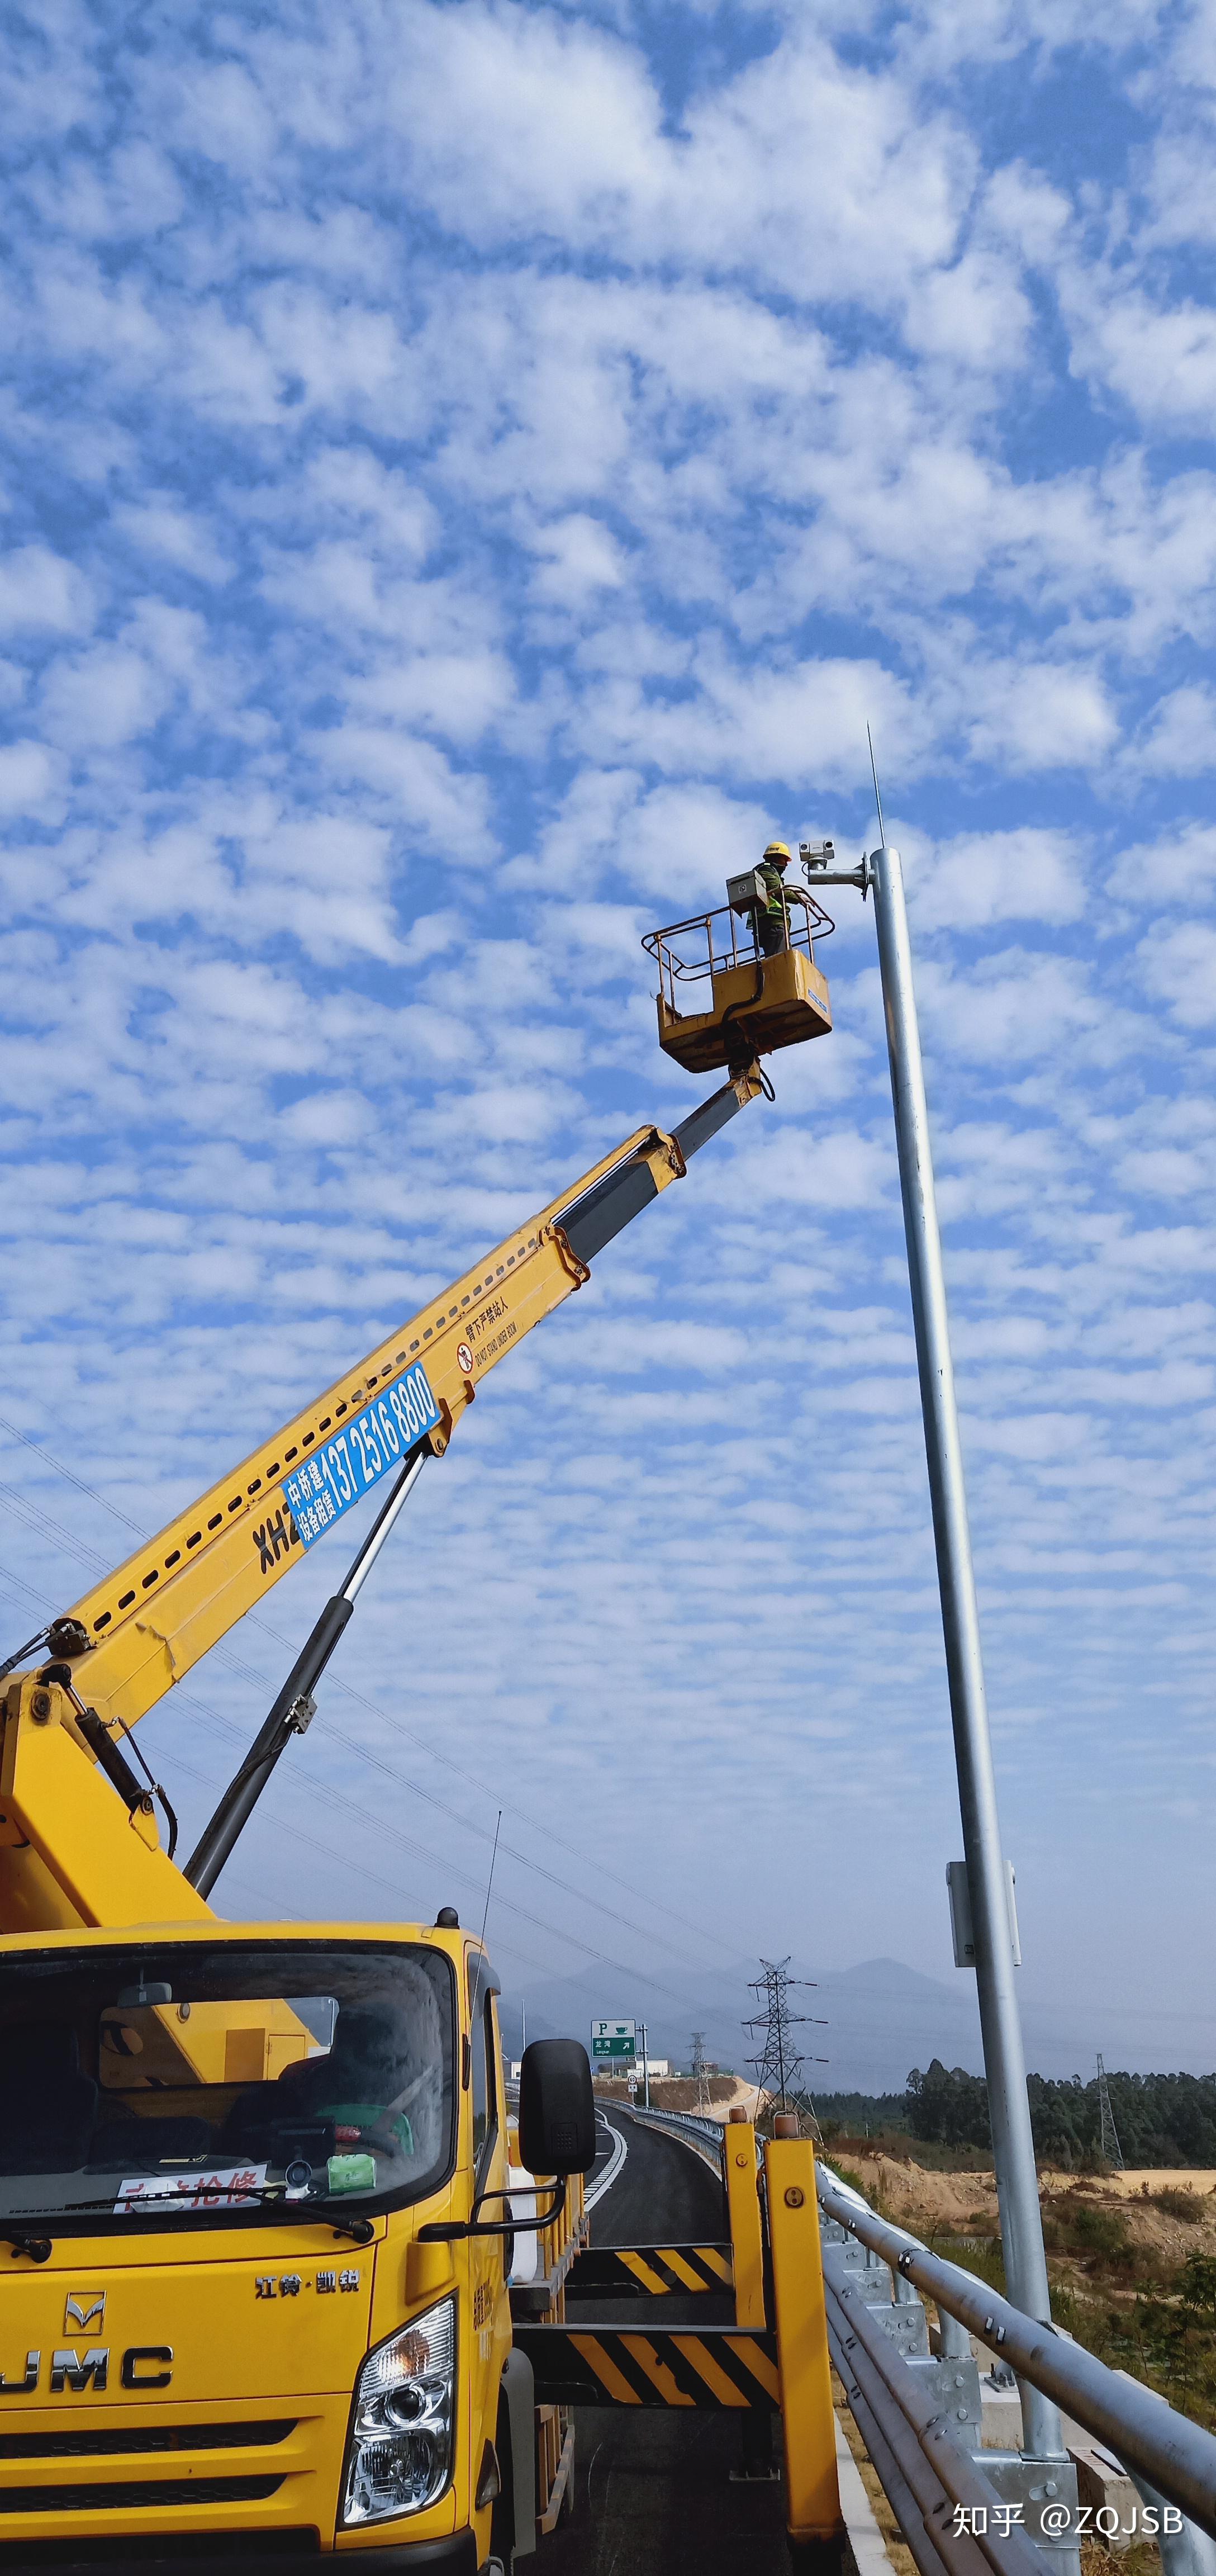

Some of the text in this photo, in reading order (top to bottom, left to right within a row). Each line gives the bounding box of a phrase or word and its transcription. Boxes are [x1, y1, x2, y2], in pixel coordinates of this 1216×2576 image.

[465, 1296, 508, 1343] 臂下严禁站人
[475, 1321, 517, 1367] DO NOT STAND UNDER BOOM
[321, 1367, 435, 1508] 137 2516 8800
[297, 1489, 336, 1541] 设备租赁
[599, 2023, 607, 2035] P
[0, 2346, 173, 2394] JMC
